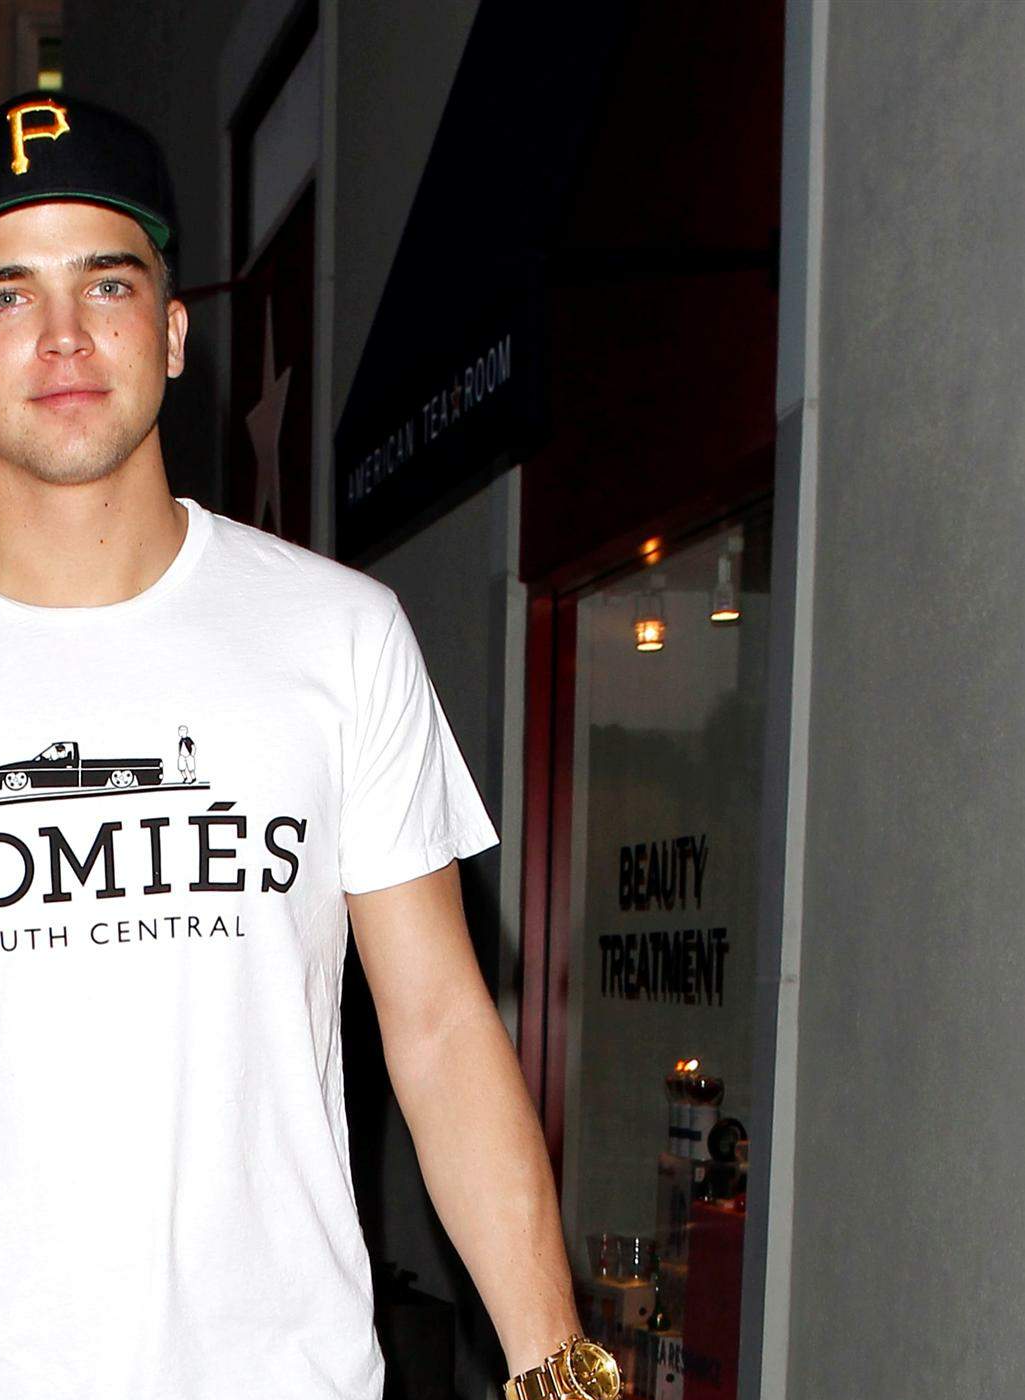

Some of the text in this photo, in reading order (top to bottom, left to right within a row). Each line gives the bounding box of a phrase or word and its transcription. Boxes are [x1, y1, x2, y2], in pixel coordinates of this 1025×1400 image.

[6, 99, 70, 176] P
[347, 333, 512, 505] AMERICAN TEA ROOM
[619, 834, 707, 911] BEAUTY
[91, 915, 245, 944] CENTRAL
[599, 928, 729, 1005] TREATMENT
